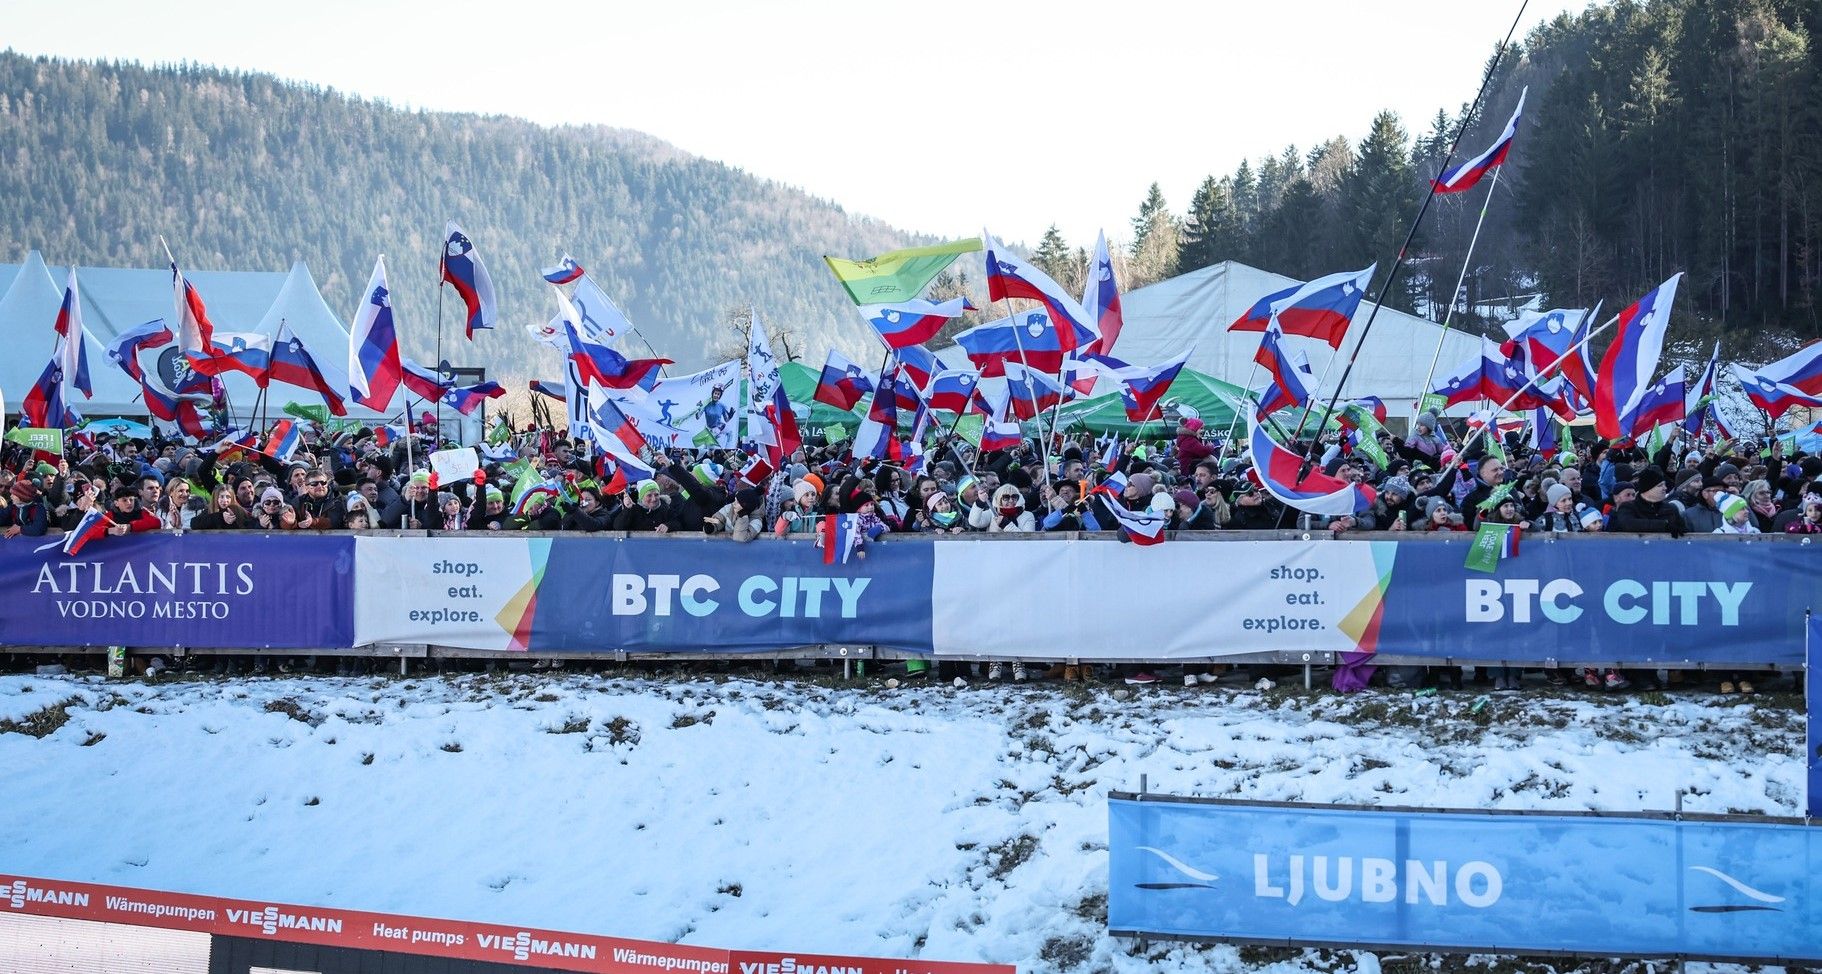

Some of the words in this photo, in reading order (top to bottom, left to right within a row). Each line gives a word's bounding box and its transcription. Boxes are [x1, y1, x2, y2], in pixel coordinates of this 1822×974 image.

[432, 560, 483, 577] shop.
[1270, 565, 1325, 583] shop.
[30, 562, 254, 595] ATLANTIS
[447, 585, 483, 598] eat.
[612, 573, 721, 617] BTC
[738, 575, 872, 619] CITY
[1285, 591, 1325, 605] eat.
[56, 600, 146, 619] VODNO
[152, 601, 230, 619] MESTO
[1465, 578, 1585, 624] BTC
[1603, 579, 1754, 626] CITY
[408, 608, 484, 625] explore.
[1242, 616, 1326, 634] explore.
[1253, 853, 1503, 908] LJUBNO
[0, 880, 90, 909] ESSMANN
[106, 895, 216, 921] Wärmepumpen
[226, 906, 343, 935] VIESSMANN
[373, 923, 408, 940] Heat
[411, 929, 465, 947] pumps
[476, 932, 597, 961] VIESSMANN
[613, 948, 729, 974] Wärmepumpen
